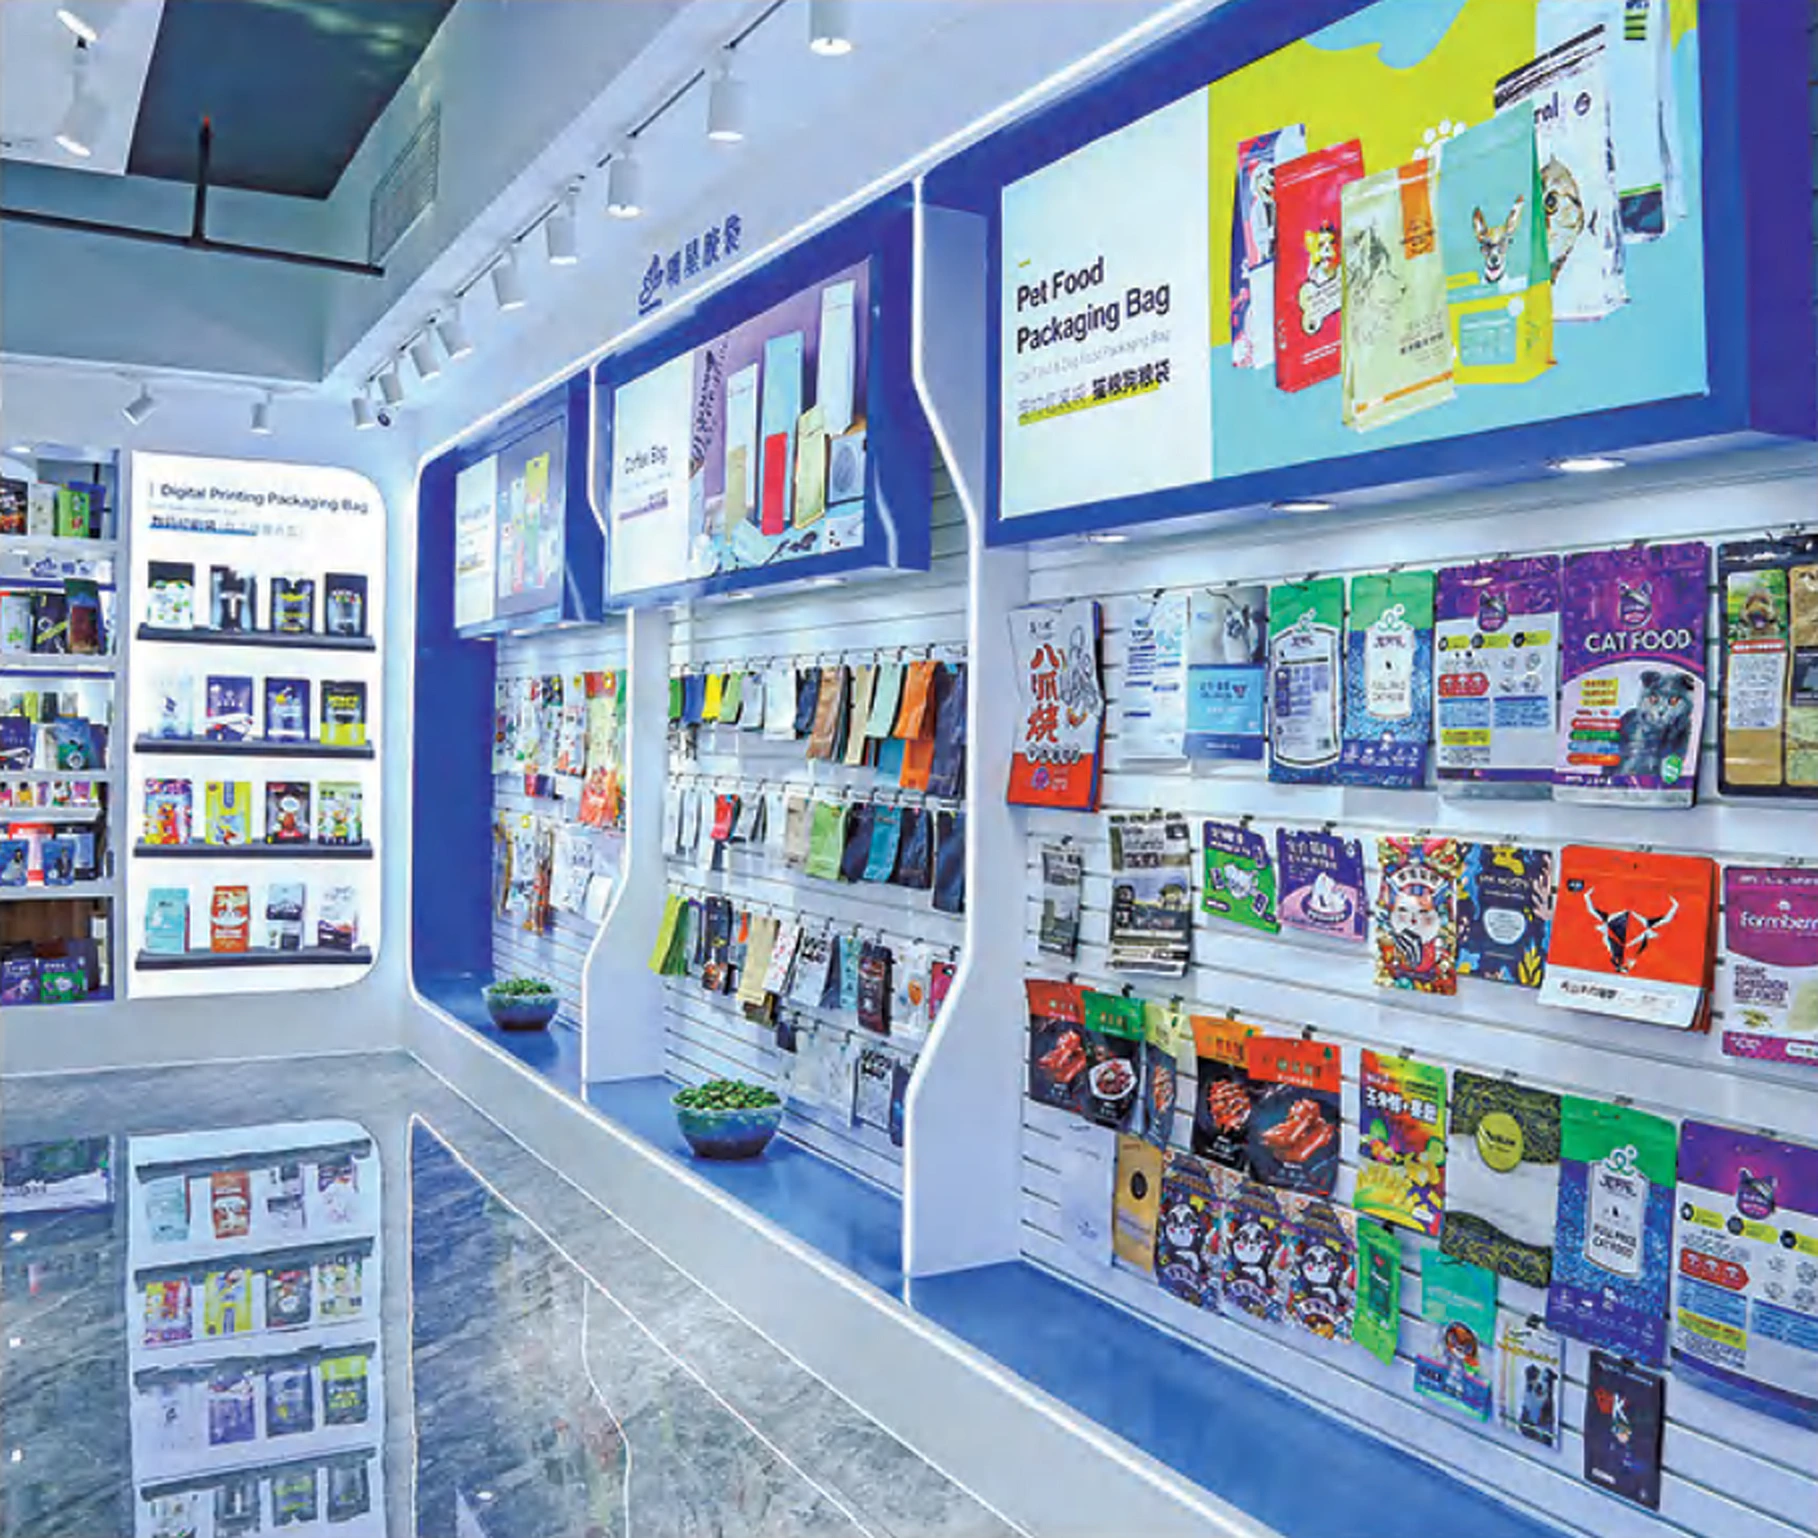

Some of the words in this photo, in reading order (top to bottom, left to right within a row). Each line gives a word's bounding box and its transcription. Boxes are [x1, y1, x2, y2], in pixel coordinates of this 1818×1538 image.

[1017, 280, 1048, 312] Pet
[1052, 255, 1104, 299] Food
[1017, 302, 1120, 354] Packaging
[1126, 284, 1170, 318] Bag
[160, 483, 207, 500] Digital
[210, 486, 265, 507] Printing
[268, 491, 339, 512] Packaging
[342, 499, 369, 515] Bag
[1585, 631, 1628, 653] CAT
[1630, 628, 1693, 651] FOOD
